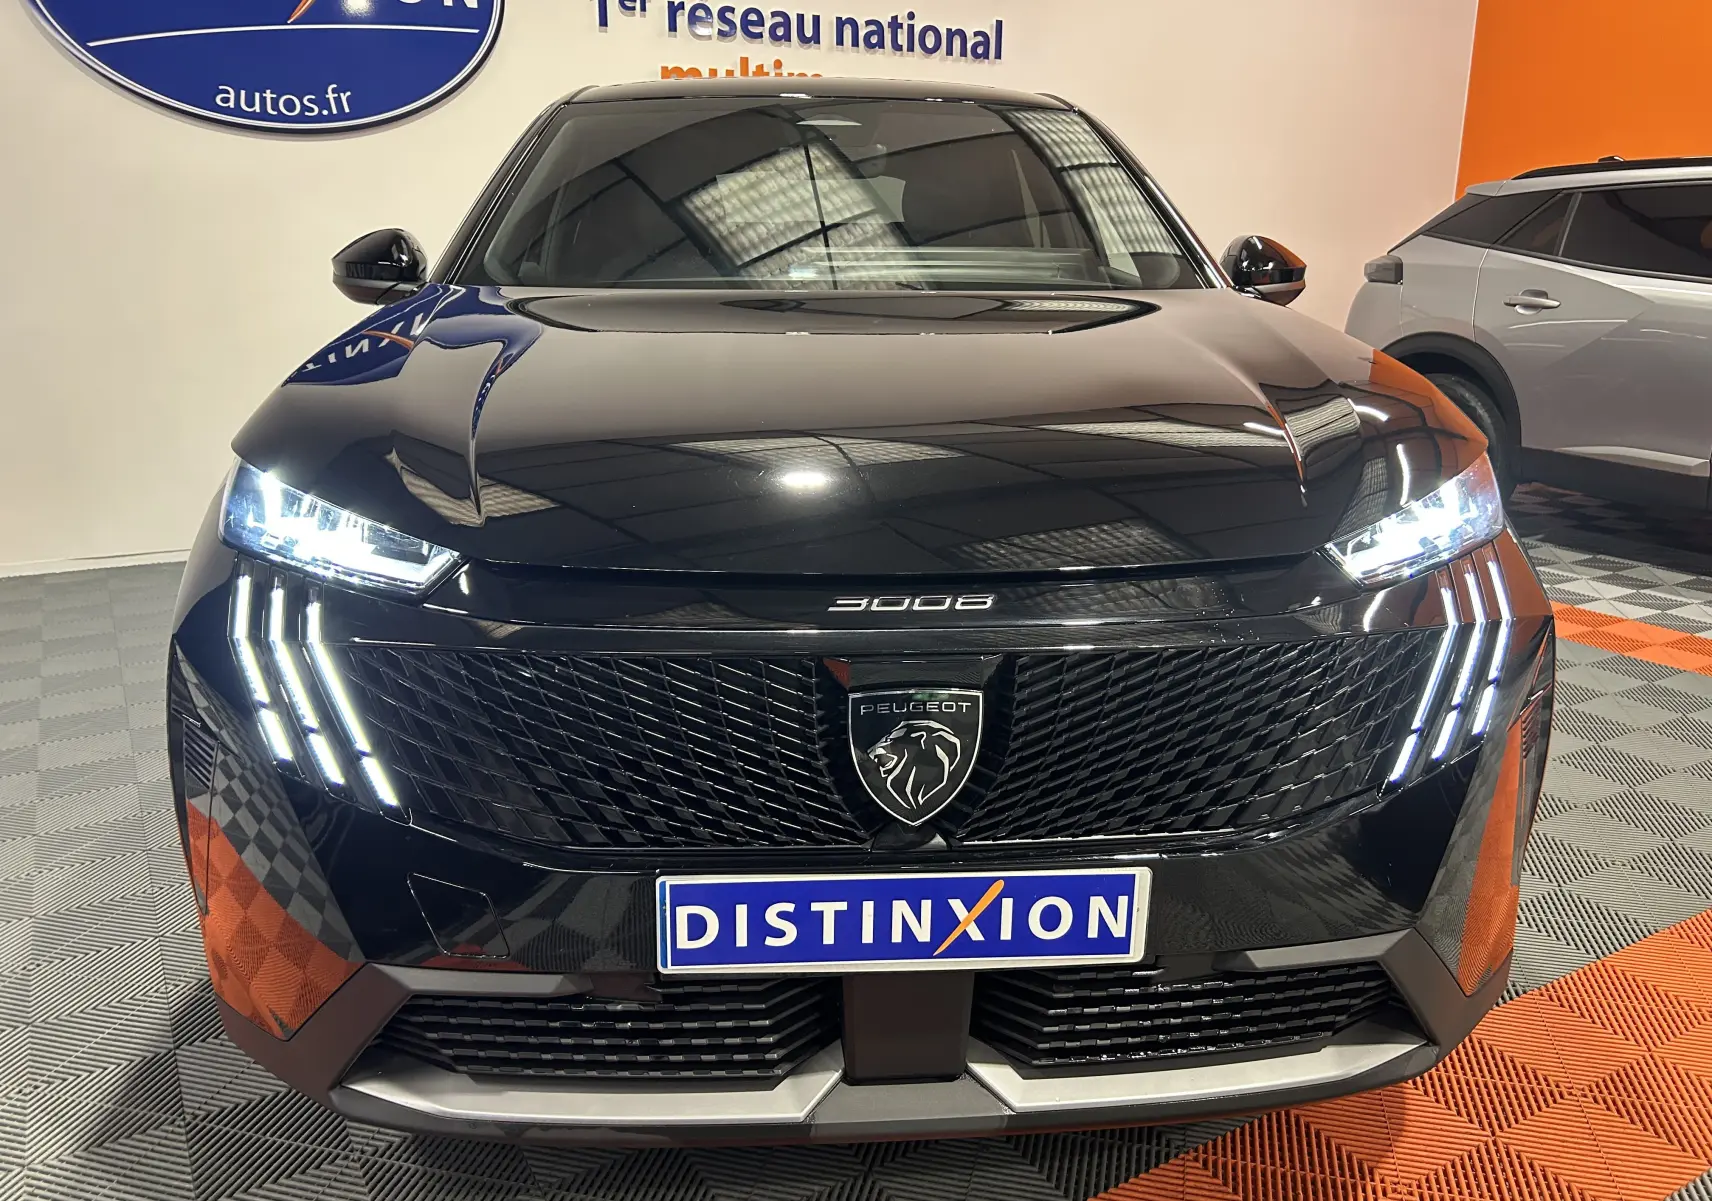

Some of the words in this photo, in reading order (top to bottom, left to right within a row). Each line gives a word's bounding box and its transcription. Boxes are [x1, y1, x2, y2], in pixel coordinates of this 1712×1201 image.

[835, 12, 1003, 61] national
[214, 84, 352, 118] autos.fr
[827, 594, 997, 612] 3008
[860, 701, 972, 715] PEUGEOT
[675, 879, 1129, 957] DISTINXION
